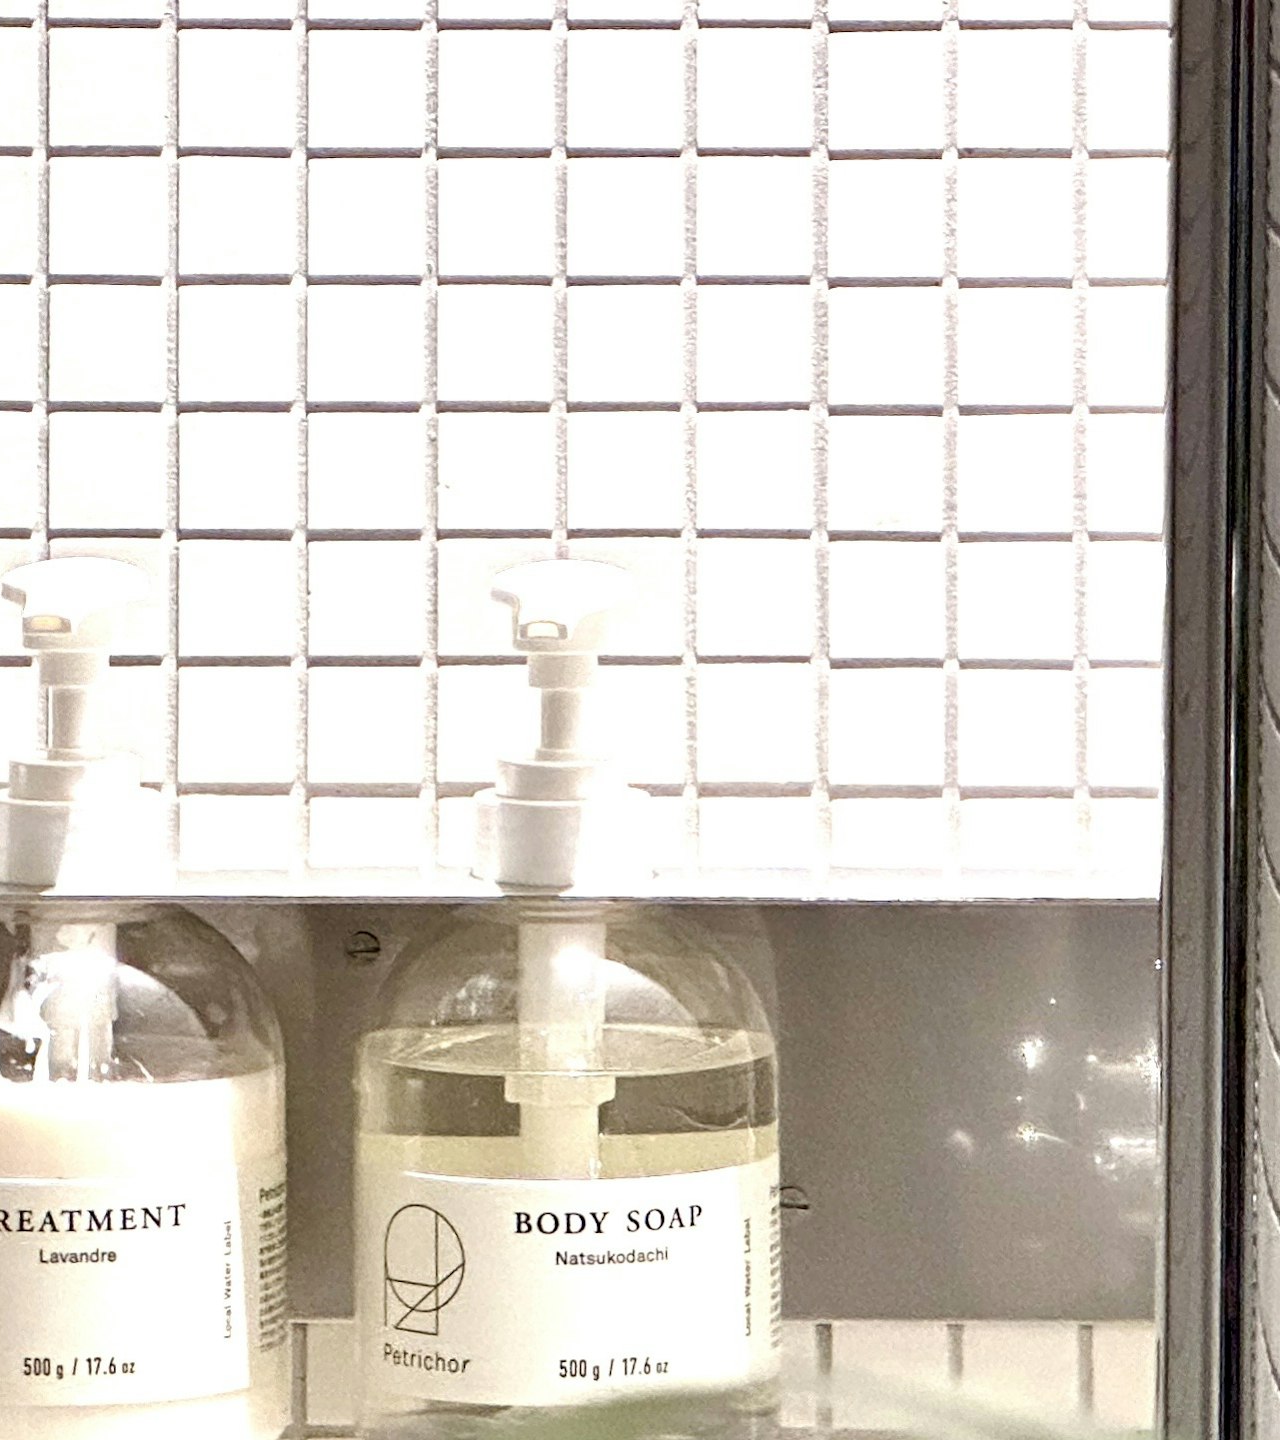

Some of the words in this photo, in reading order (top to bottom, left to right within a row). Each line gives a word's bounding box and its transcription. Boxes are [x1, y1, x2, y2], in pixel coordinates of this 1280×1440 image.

[514, 1211, 610, 1235] BODY
[626, 1204, 703, 1233] SOAP
[38, 1248, 118, 1265] Lavandre
[555, 1247, 669, 1266] Natsukodachi
[23, 1357, 51, 1377] 500
[56, 1365, 64, 1379] g
[72, 1358, 78, 1376] /
[85, 1357, 117, 1376] 17.6
[122, 1360, 136, 1375] oz
[383, 1343, 471, 1374] Petrichor
[559, 1359, 587, 1378] 500
[592, 1366, 600, 1381] g
[608, 1358, 615, 1376] /
[622, 1357, 652, 1376] 17.6
[656, 1360, 669, 1374] oz
